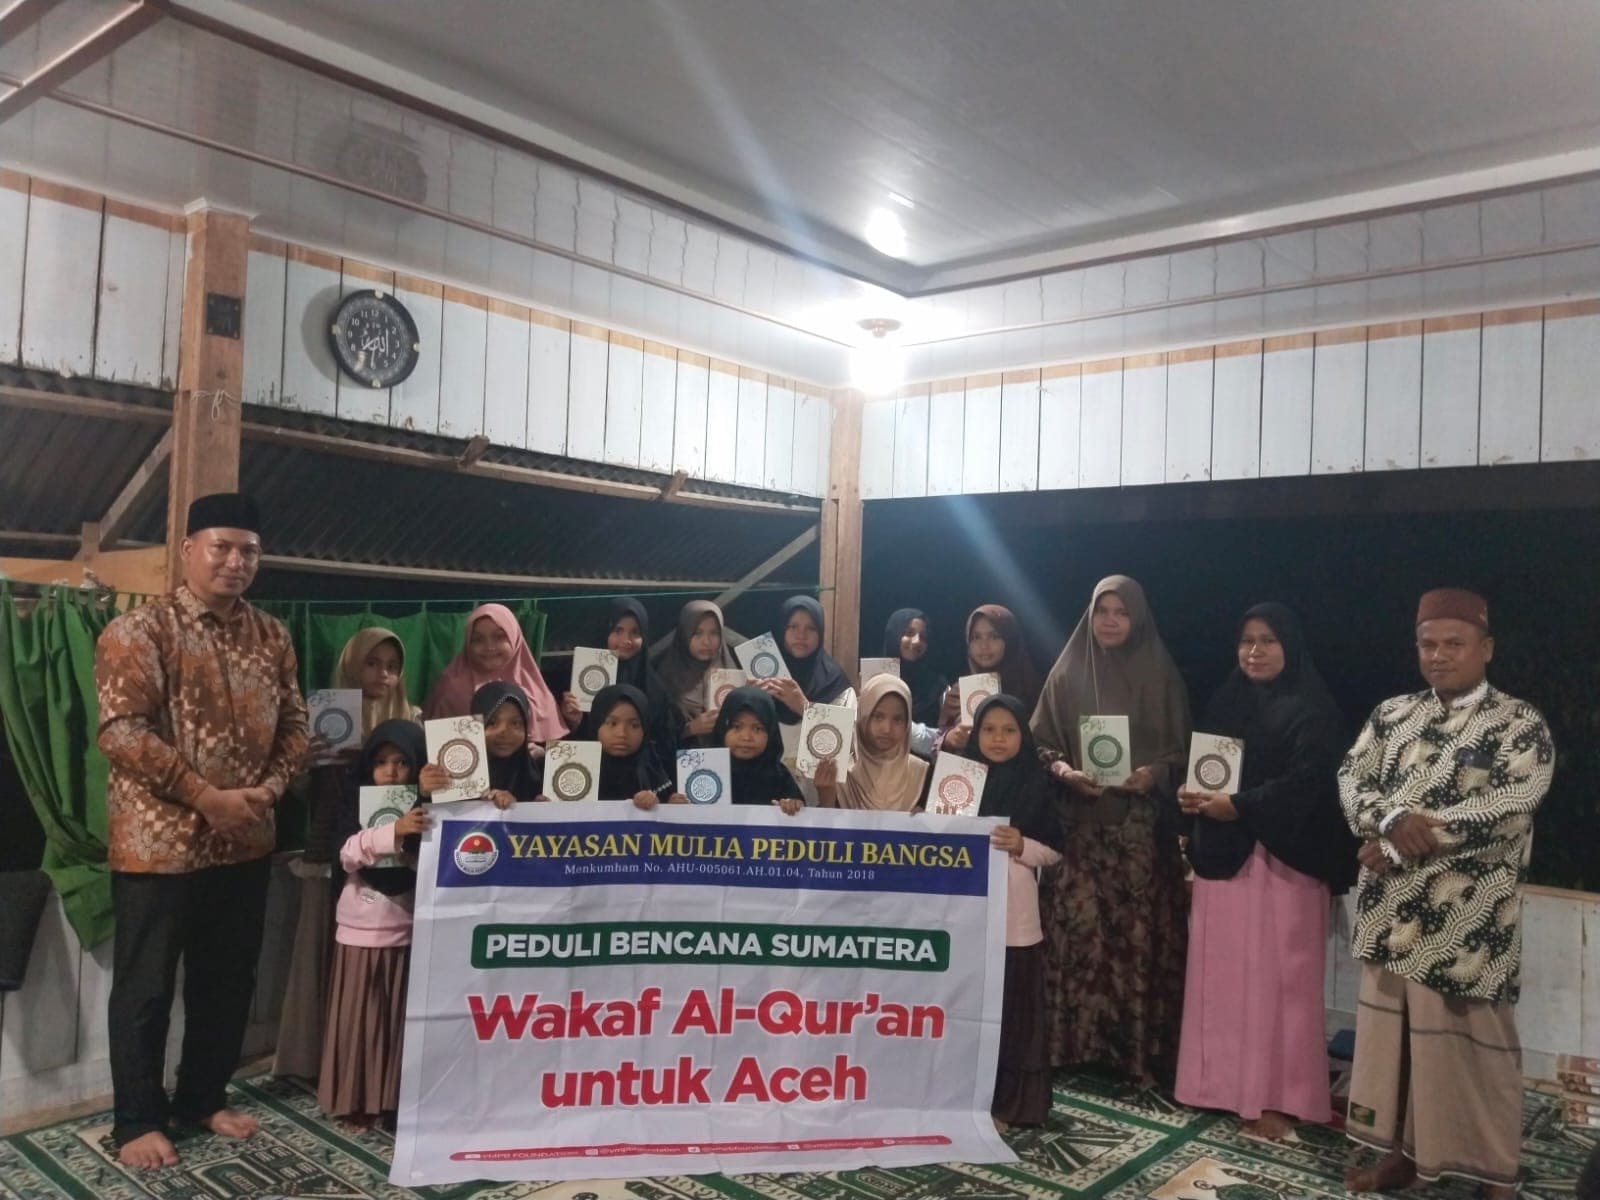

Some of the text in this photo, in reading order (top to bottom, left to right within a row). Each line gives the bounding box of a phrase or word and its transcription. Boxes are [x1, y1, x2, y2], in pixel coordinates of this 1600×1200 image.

[351, 318, 360, 326] 10
[361, 310, 368, 318] 11
[371, 309, 379, 317] 12
[508, 833, 973, 869] YAYASAN MULIA PEDULI BANGSA
[564, 862, 639, 875] Menkumham
[643, 862, 663, 873] No.
[808, 867, 843, 879] Tahun
[847, 869, 876, 880] 2018
[485, 931, 937, 963] PEDULI BENCANA SUMATERA
[467, 987, 662, 1041] Wakaf
[541, 1054, 868, 1108] untuk Aceh
